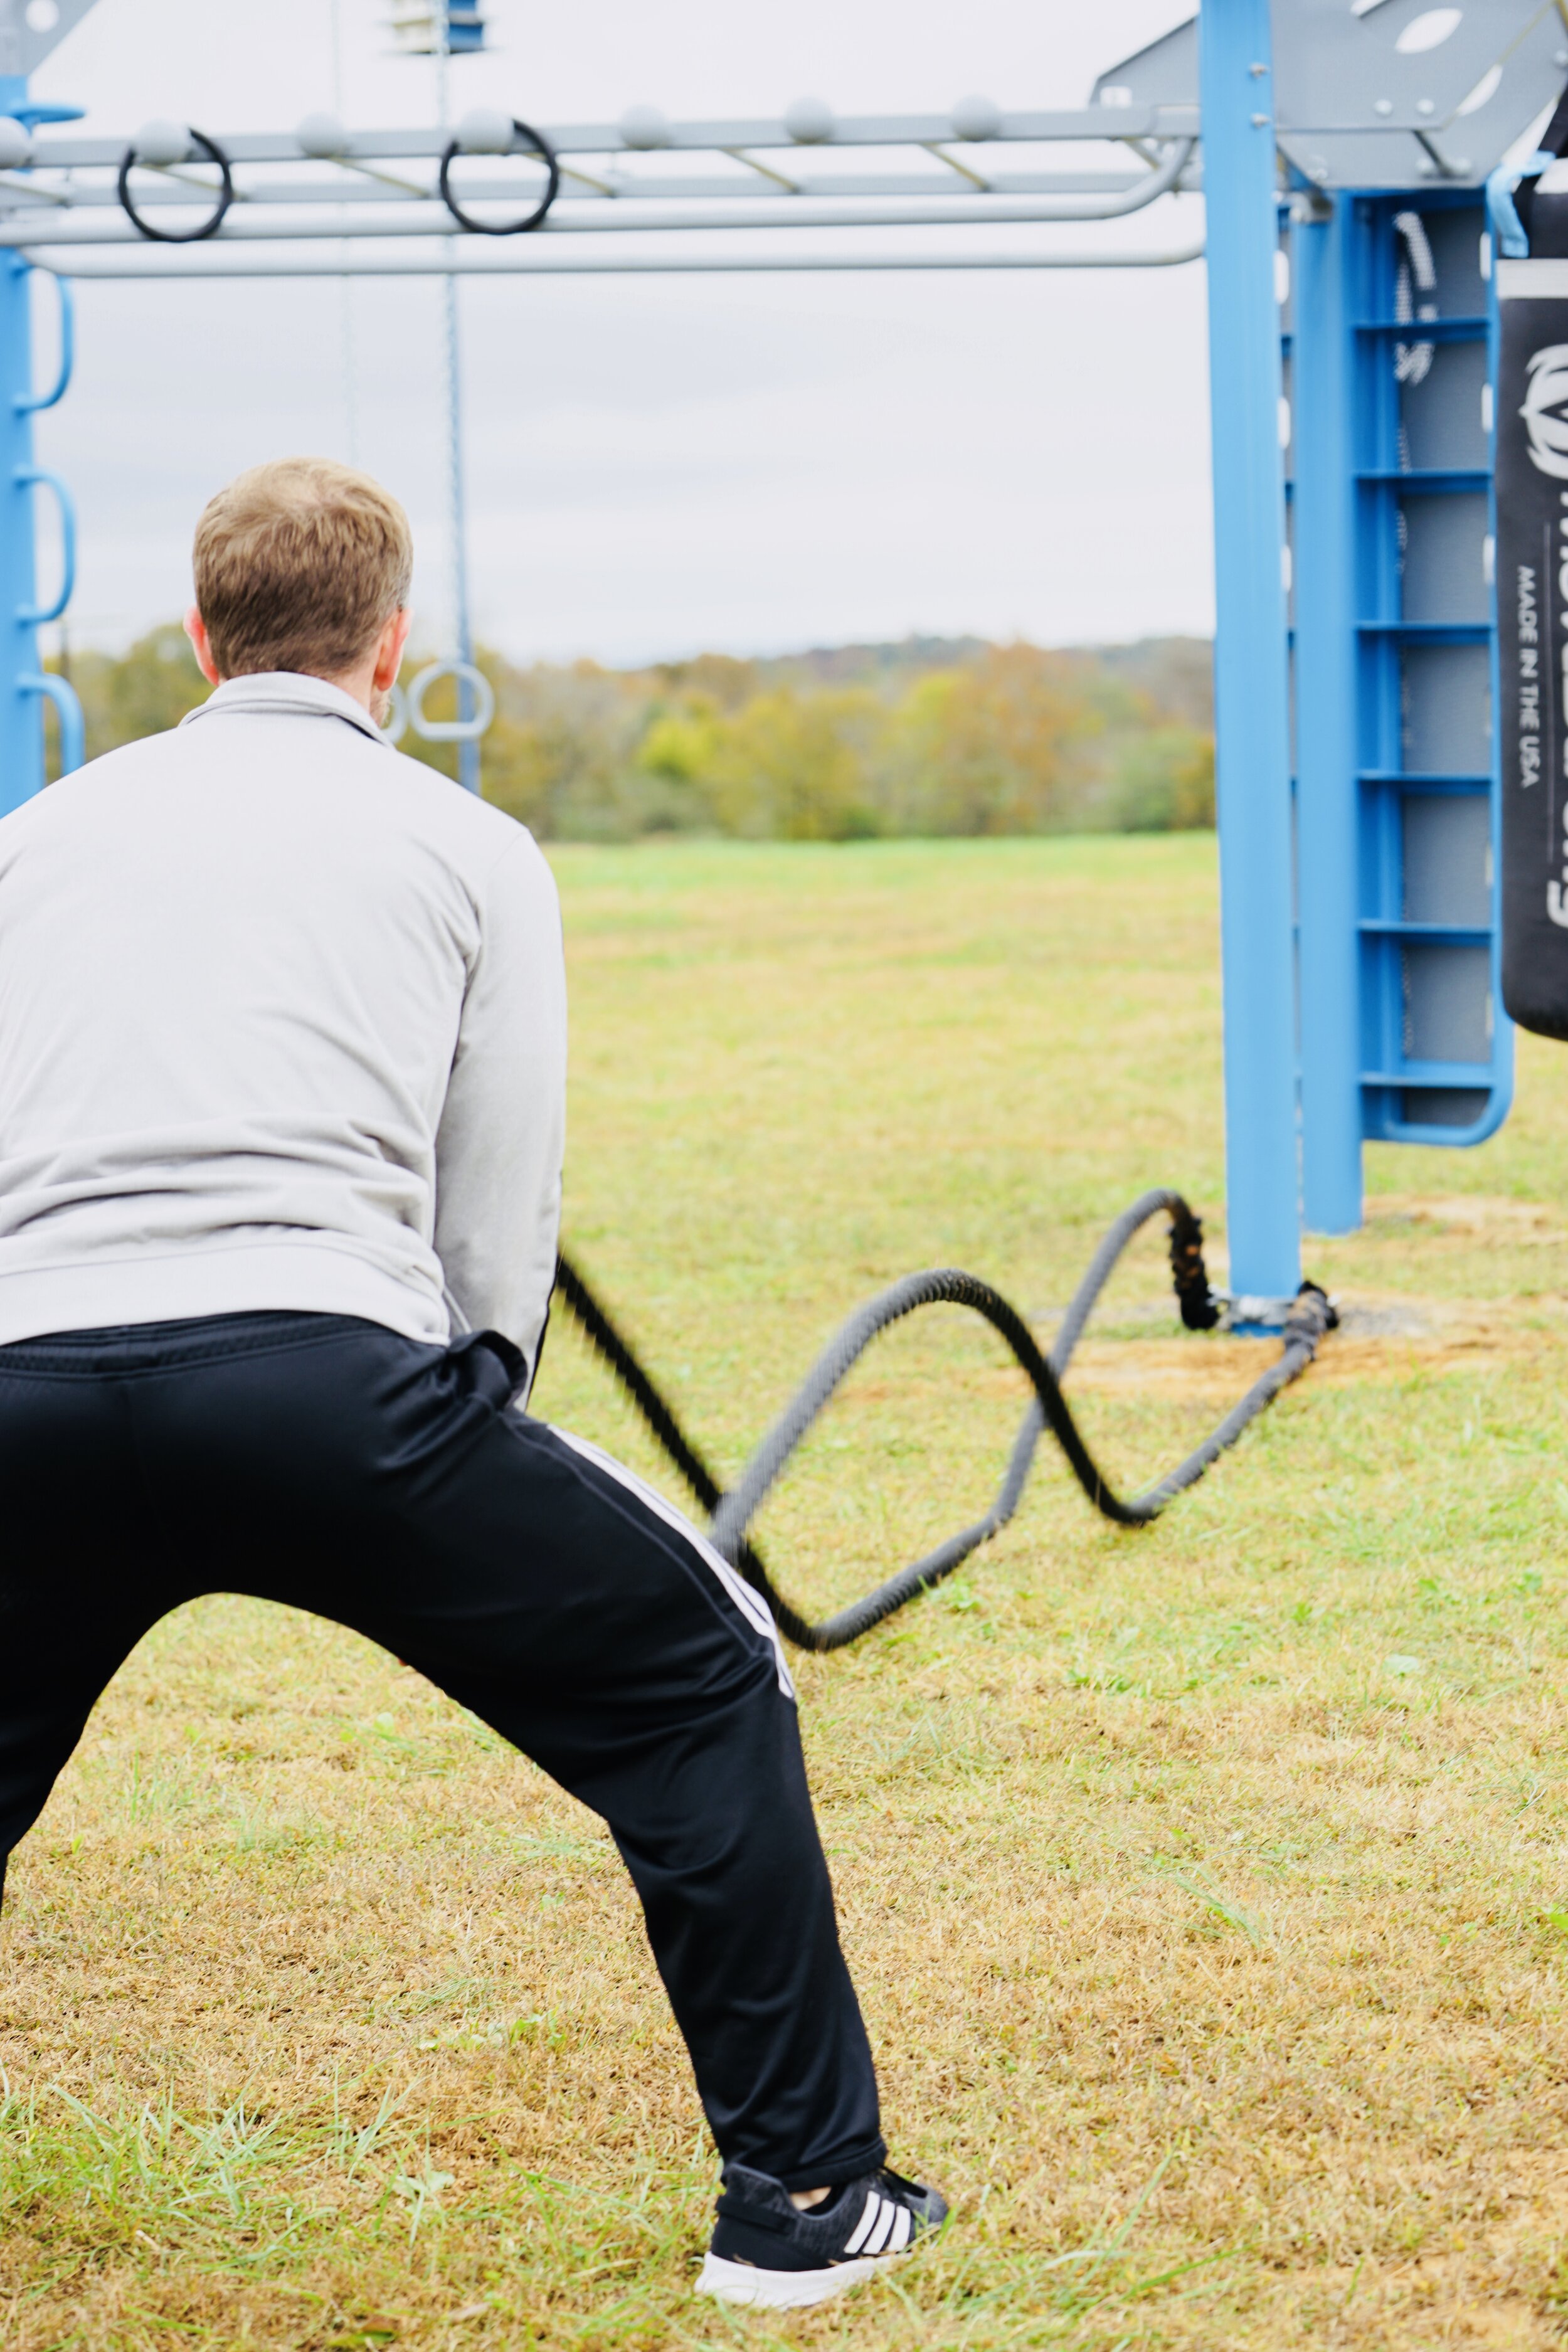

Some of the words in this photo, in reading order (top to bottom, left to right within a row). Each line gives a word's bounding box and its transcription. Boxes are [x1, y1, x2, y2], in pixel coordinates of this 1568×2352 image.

[1518, 565, 1538, 644] MADE
[1519, 648, 1539, 678] IN
[1519, 684, 1539, 730] THE
[1518, 735, 1540, 788] USA
